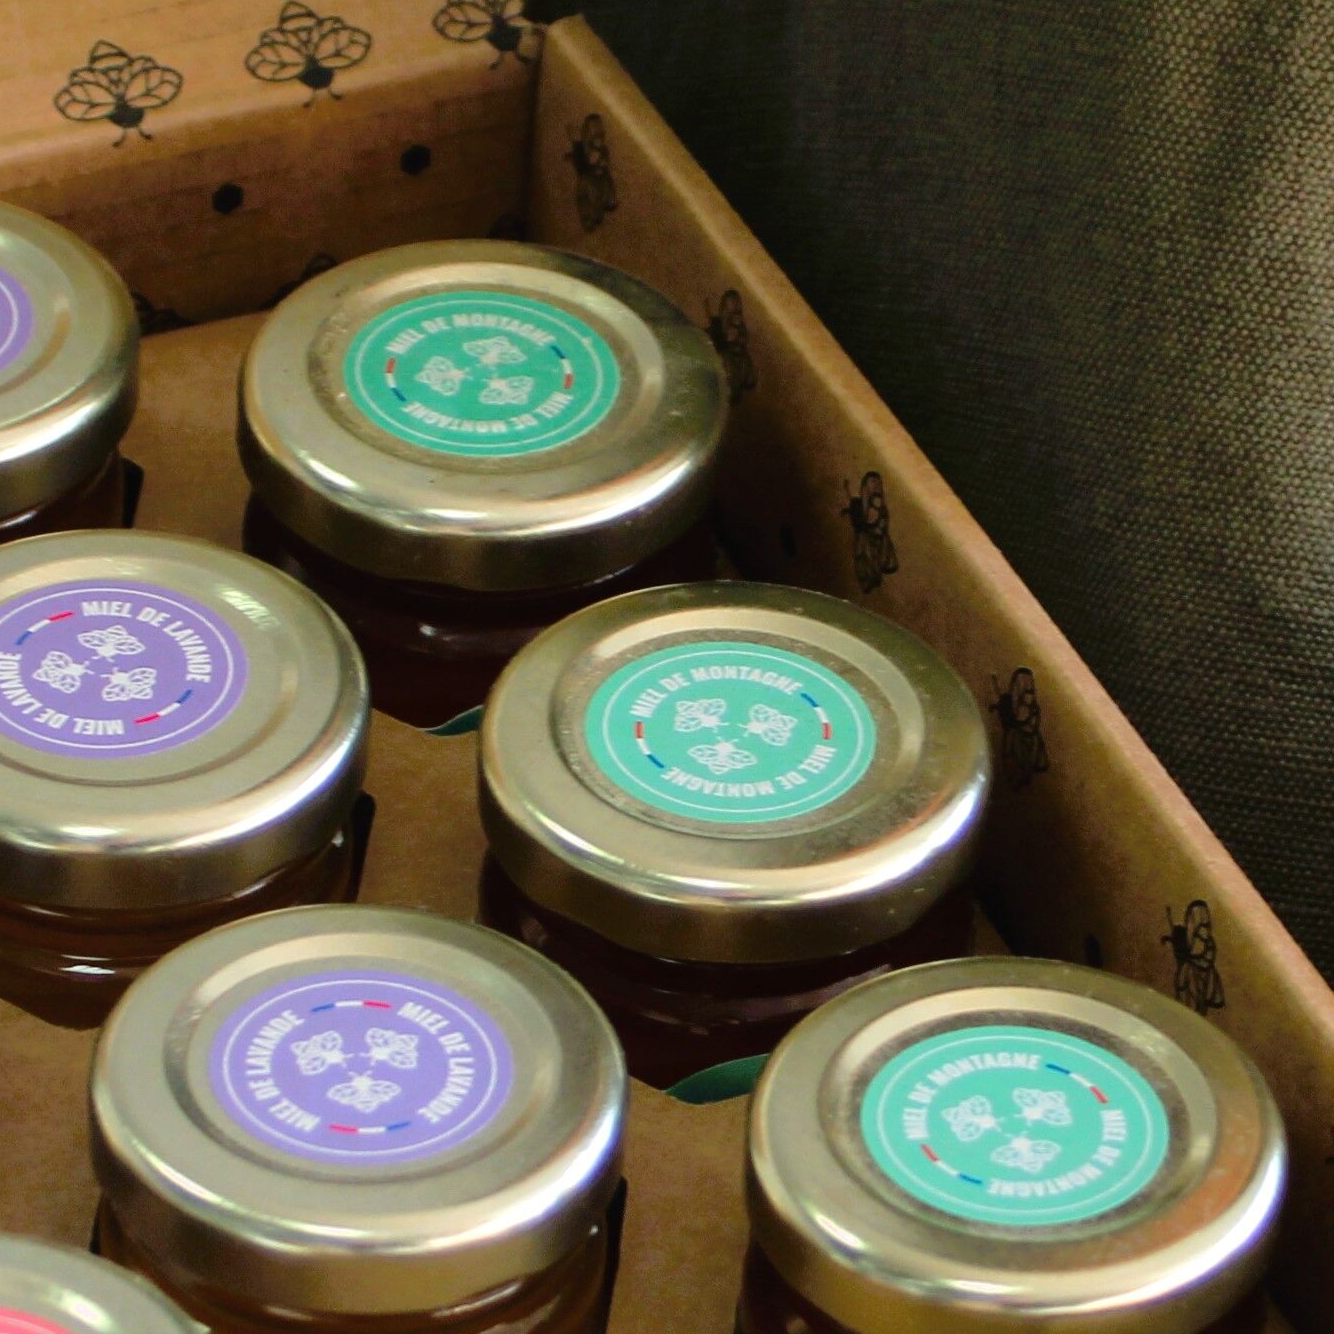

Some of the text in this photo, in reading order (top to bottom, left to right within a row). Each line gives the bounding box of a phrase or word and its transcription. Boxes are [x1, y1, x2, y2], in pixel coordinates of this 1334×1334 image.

[387, 313, 556, 355] MIEL DE MONTAGNE
[81, 600, 213, 684] MIEL DE LAVANDE
[34, 707, 69, 730] DE
[73, 717, 125, 736] MIEL
[630, 665, 803, 719] MIEL DE MONTAGNE
[660, 744, 838, 798] MIEL DE MONTAGNE
[245, 1009, 322, 1134] MIEL DE LAVANDE
[397, 1000, 476, 1124] MIEL DE LAVANDE
[902, 1052, 1042, 1140] MIEL DE MONTAGNE
[987, 1108, 1127, 1198] MIEL DE MONTAGNE
